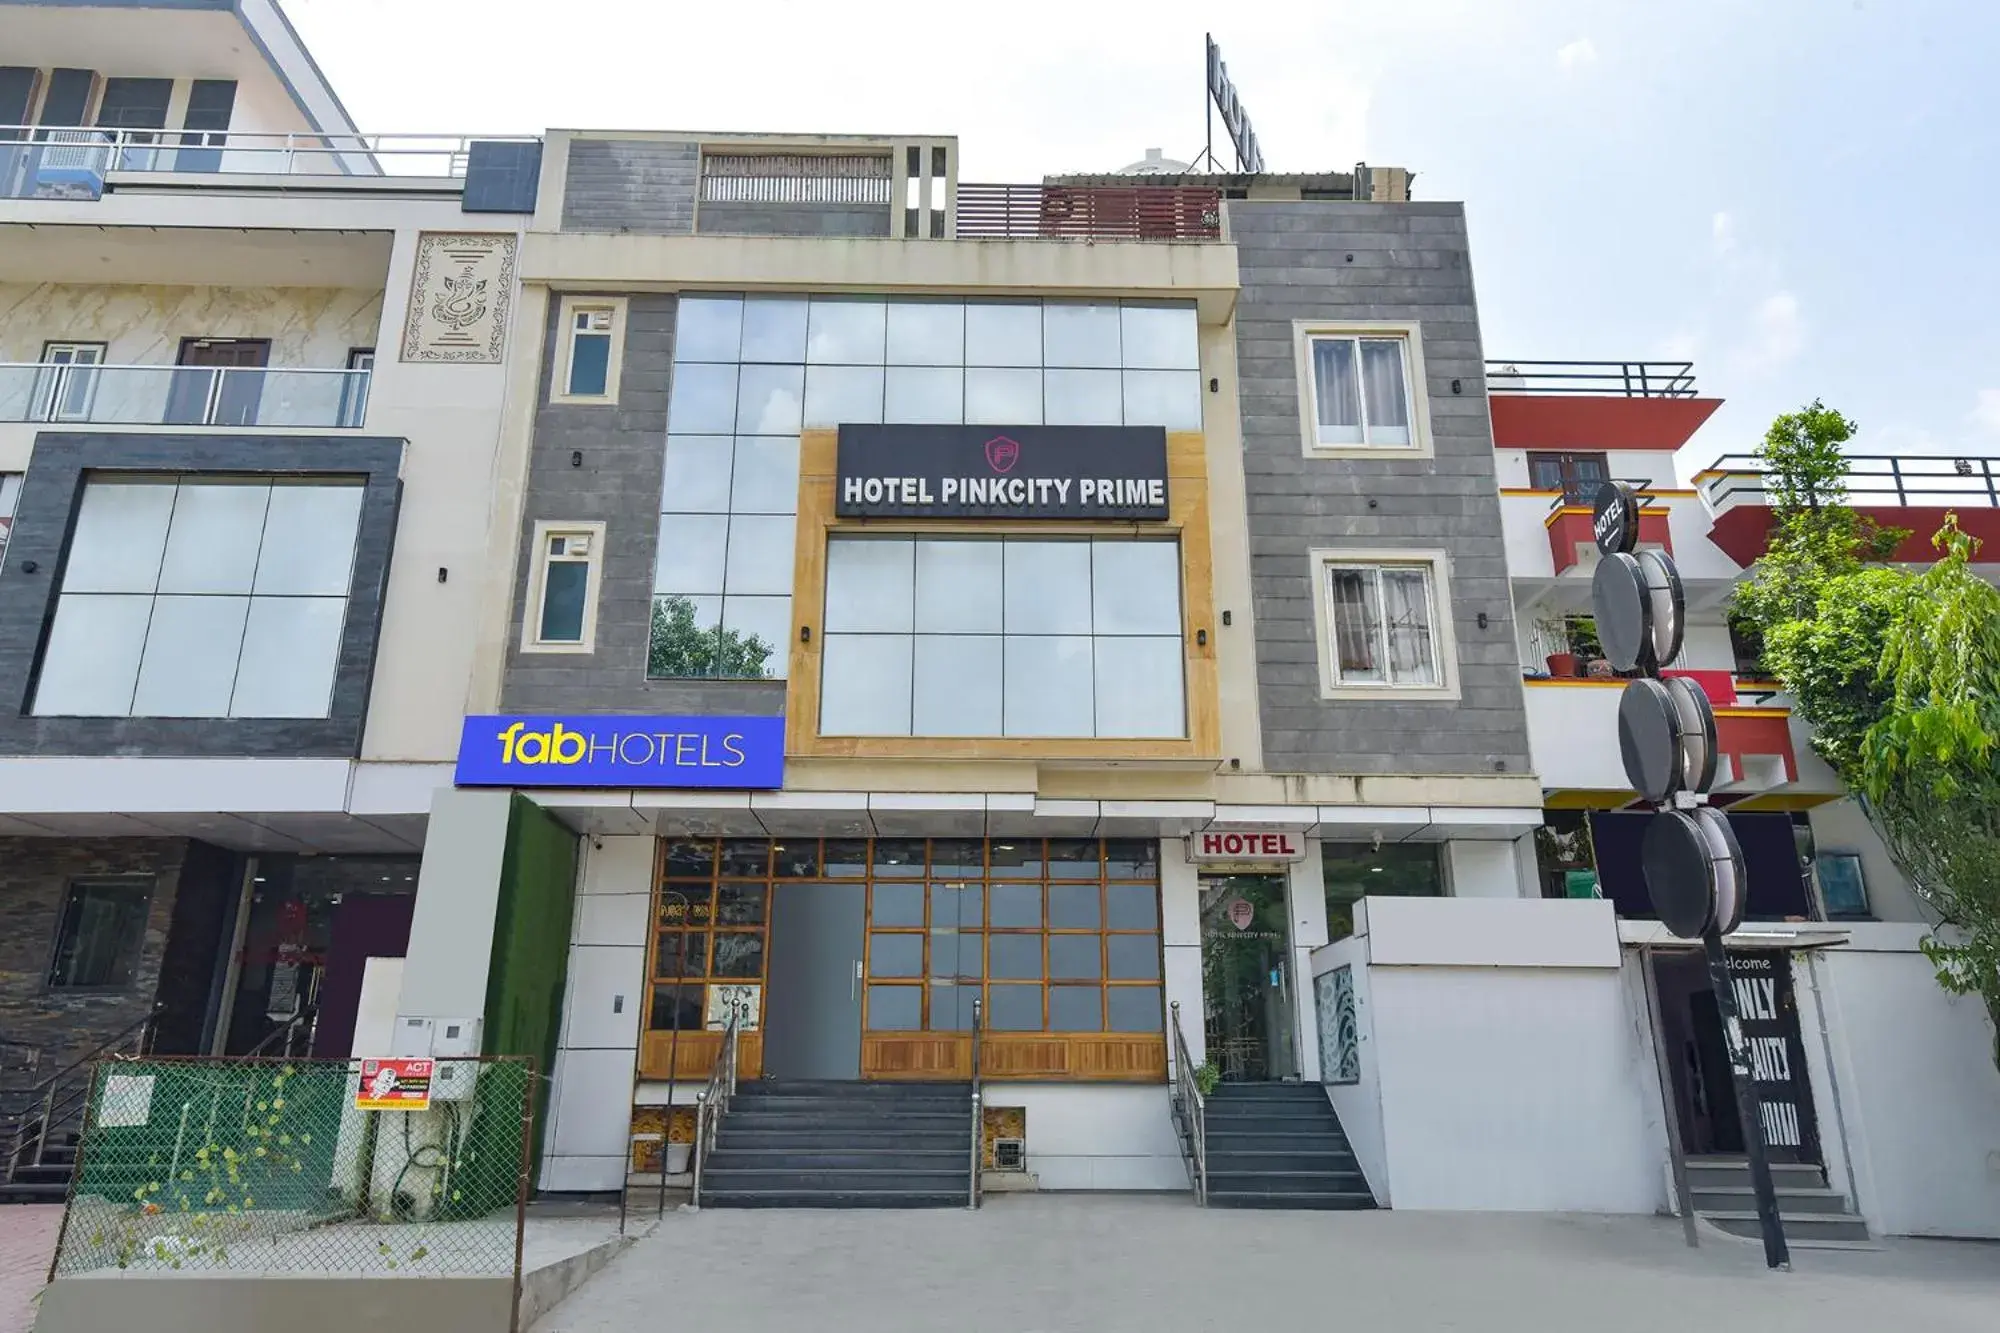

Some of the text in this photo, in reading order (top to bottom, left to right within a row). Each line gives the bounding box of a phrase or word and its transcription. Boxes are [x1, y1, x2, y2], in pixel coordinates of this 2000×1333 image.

[844, 477, 1166, 506] HOTEL PINKCITY PRIME
[1594, 498, 1623, 540] HOTEL
[497, 722, 746, 767] fabHOTELS
[1203, 834, 1296, 854] HOTEL
[405, 1061, 431, 1072] ACT
